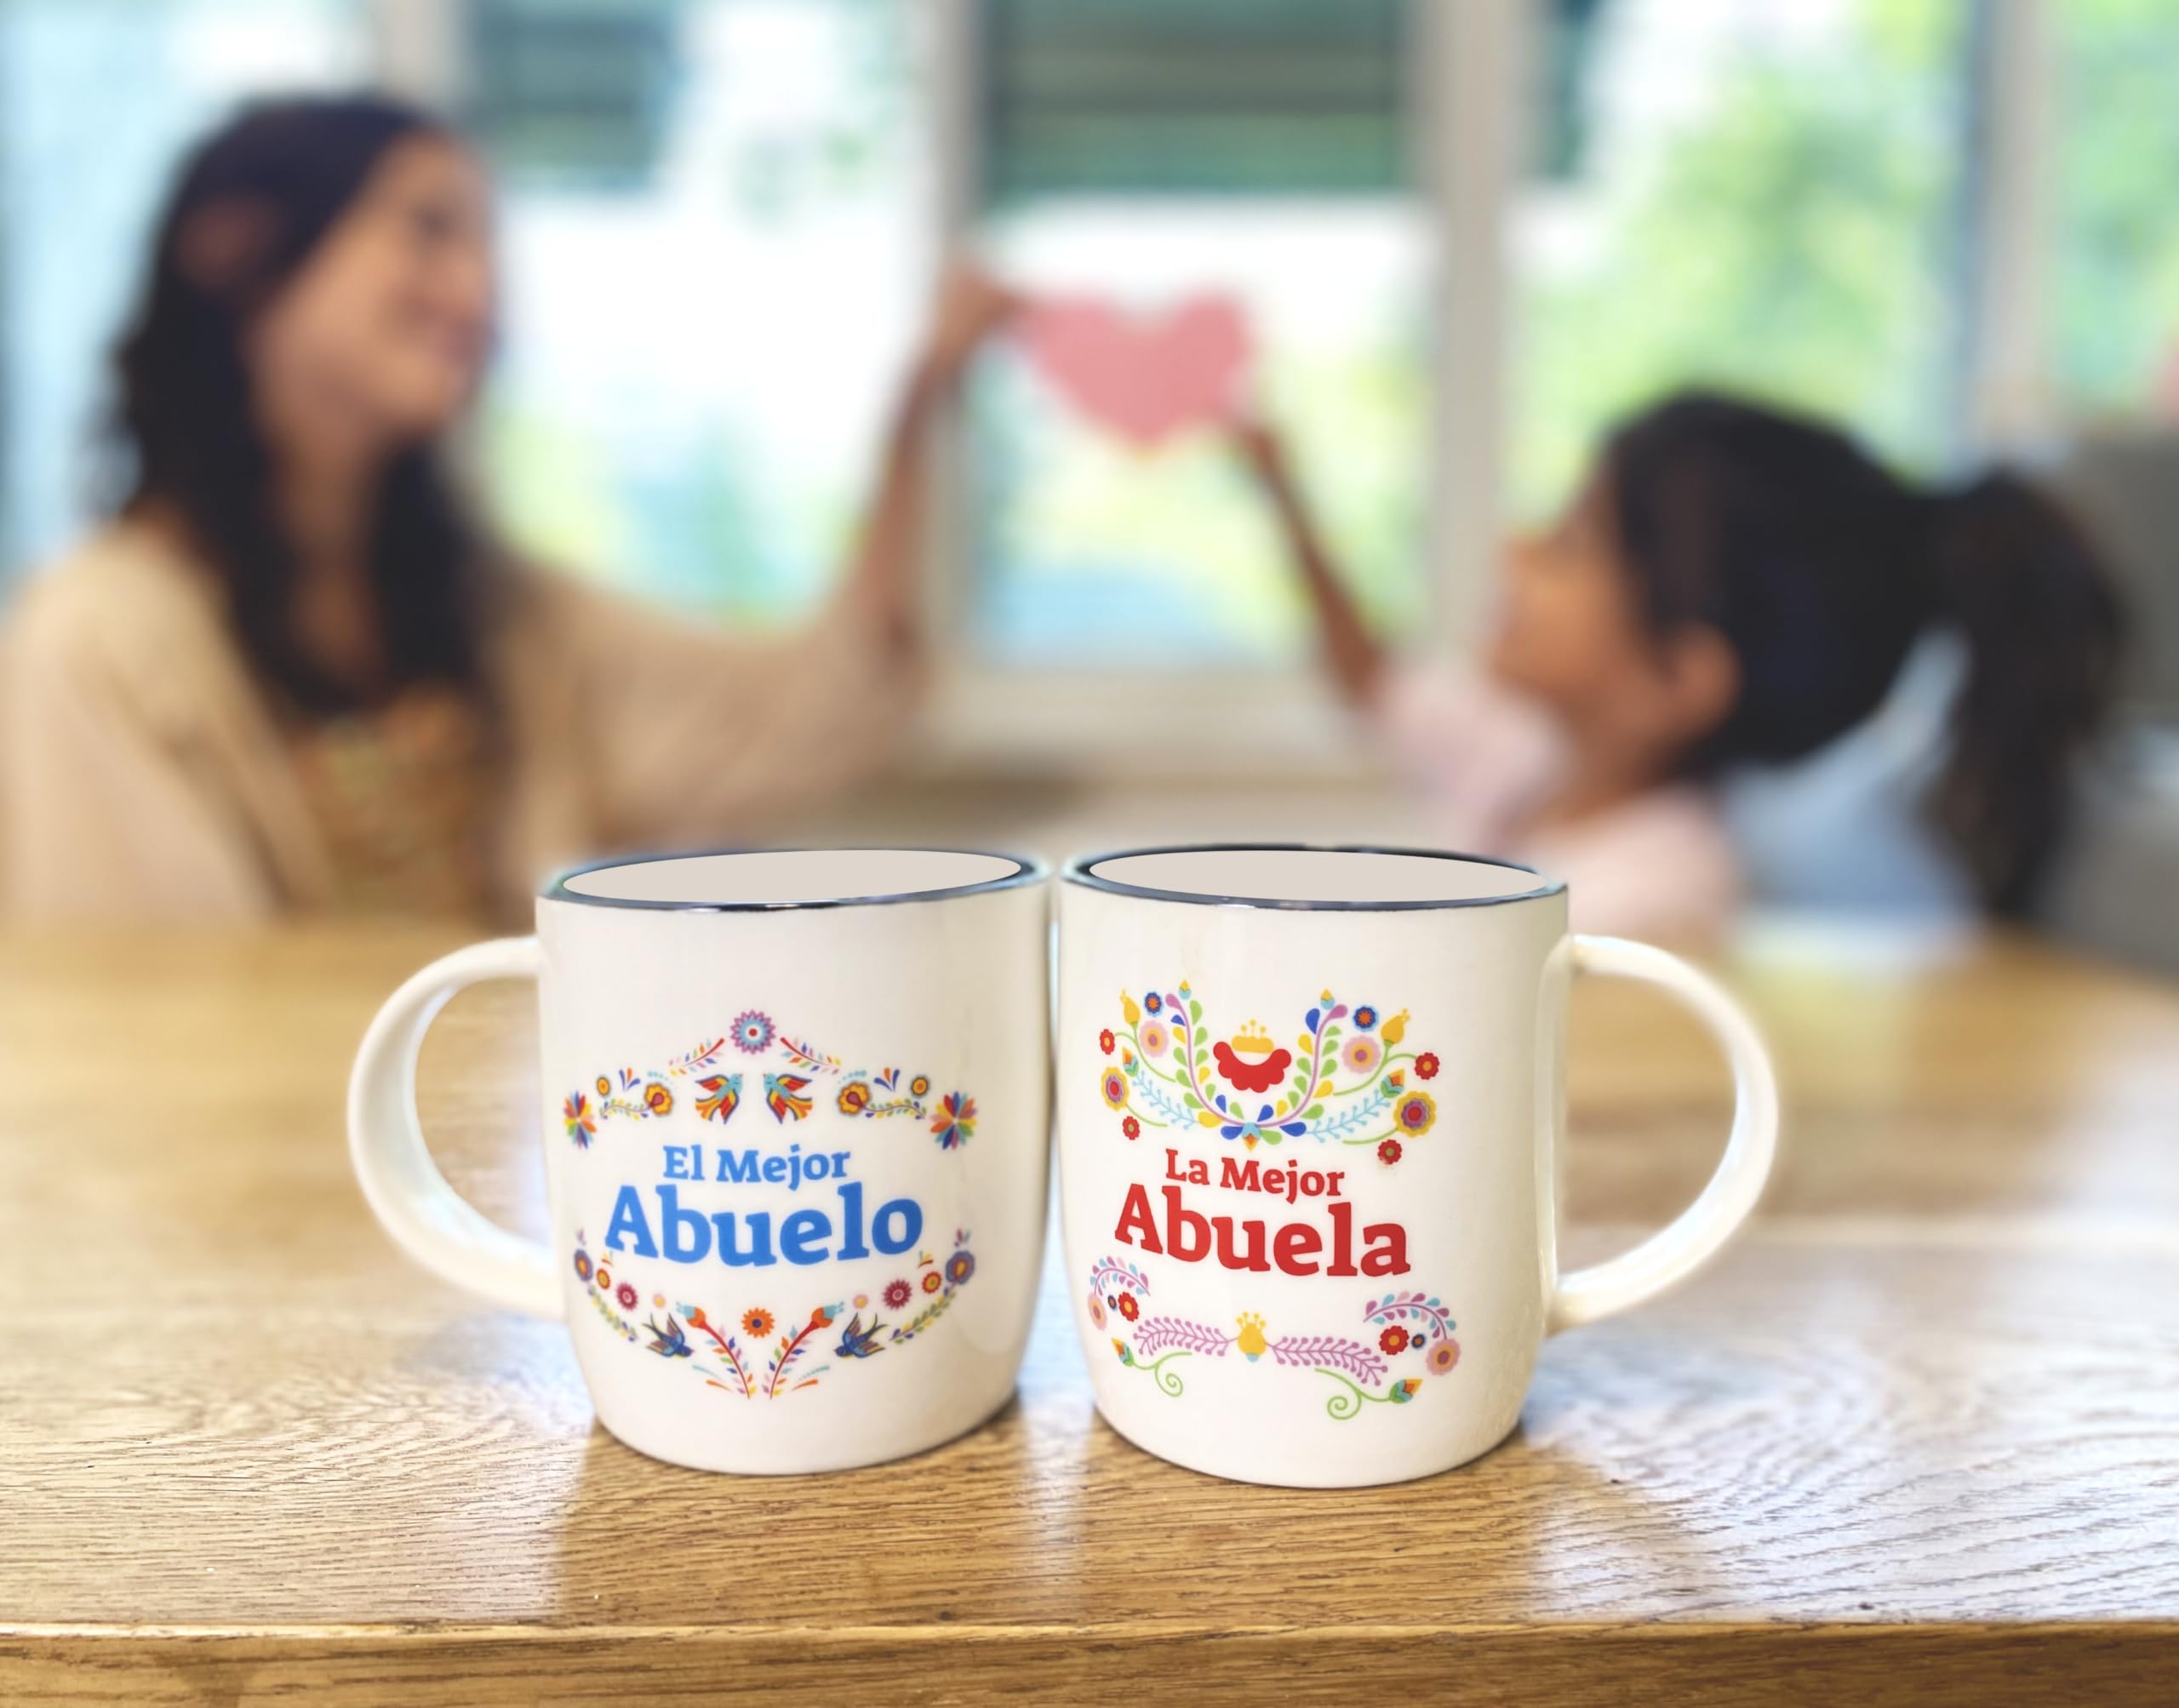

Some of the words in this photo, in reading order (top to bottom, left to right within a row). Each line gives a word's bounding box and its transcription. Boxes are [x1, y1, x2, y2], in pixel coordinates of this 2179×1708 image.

[663, 1145, 704, 1181] El
[716, 1144, 850, 1191] Mejor
[1165, 1148, 1210, 1185] La
[1220, 1157, 1345, 1205] Mejor
[604, 1181, 924, 1267] Abuelo
[1114, 1183, 1411, 1277] Abuela
